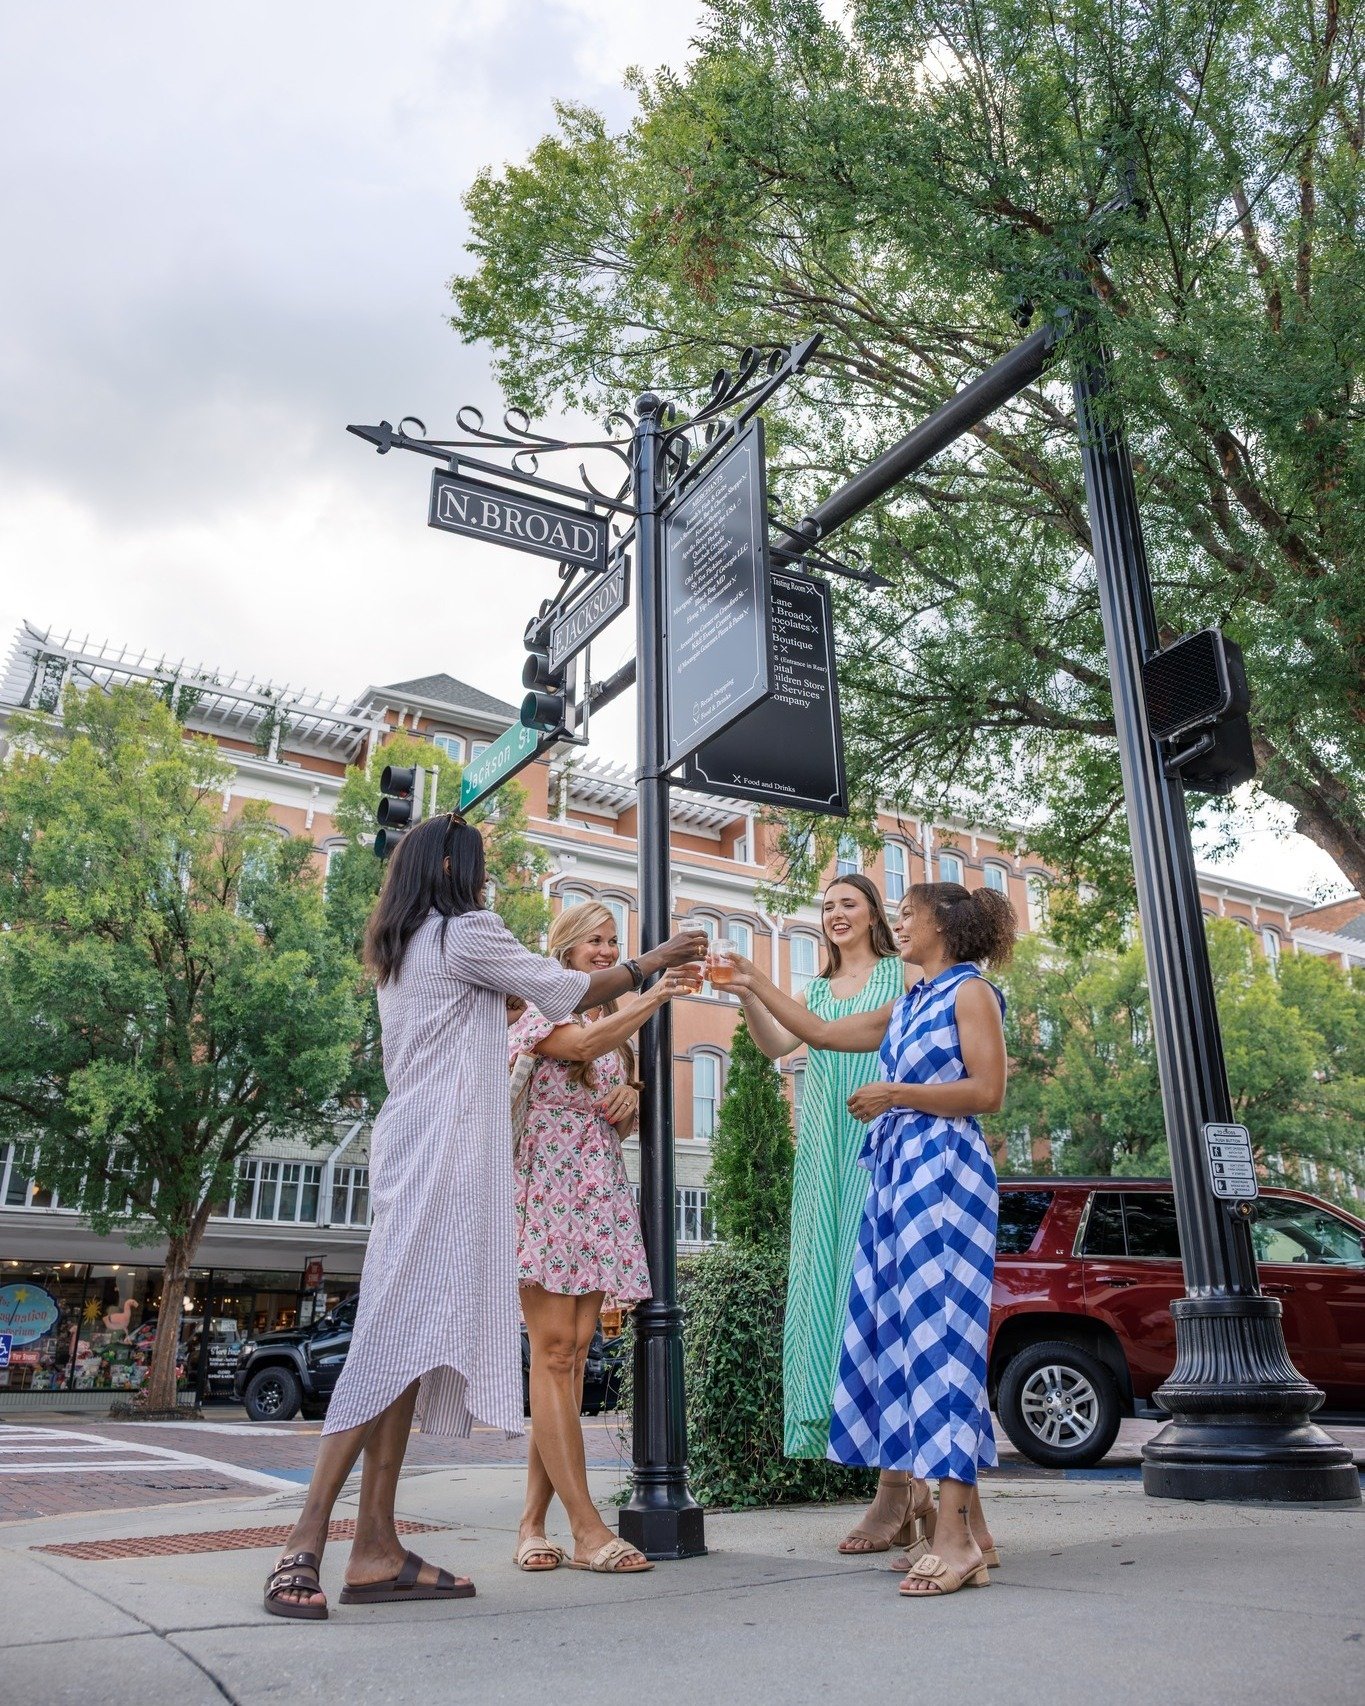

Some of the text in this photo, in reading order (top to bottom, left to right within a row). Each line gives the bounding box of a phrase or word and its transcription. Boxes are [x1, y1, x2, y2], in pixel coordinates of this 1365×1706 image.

[692, 473, 722, 508] MERCHANTS
[695, 527, 713, 546] Records
[725, 503, 736, 516] USA
[707, 530, 720, 544] Perks
[693, 535, 724, 567] Sunbelt Credit
[684, 573, 693, 585] Old
[707, 540, 728, 563] Nutrition
[693, 576, 713, 597] Solutions
[718, 555, 737, 573] Georgia
[737, 542, 748, 557] LLC
[694, 574, 725, 606] Black Bag MD
[791, 582, 806, 593] Room
[771, 595, 792, 607] Lane
[777, 606, 804, 621] Broad
[773, 633, 813, 650] Boutique
[781, 683, 820, 700] Services
[803, 678, 826, 692] Store
[770, 694, 811, 709] ompany
[466, 727, 531, 794] Jackson St
[743, 777, 796, 793] Food and Drinks
